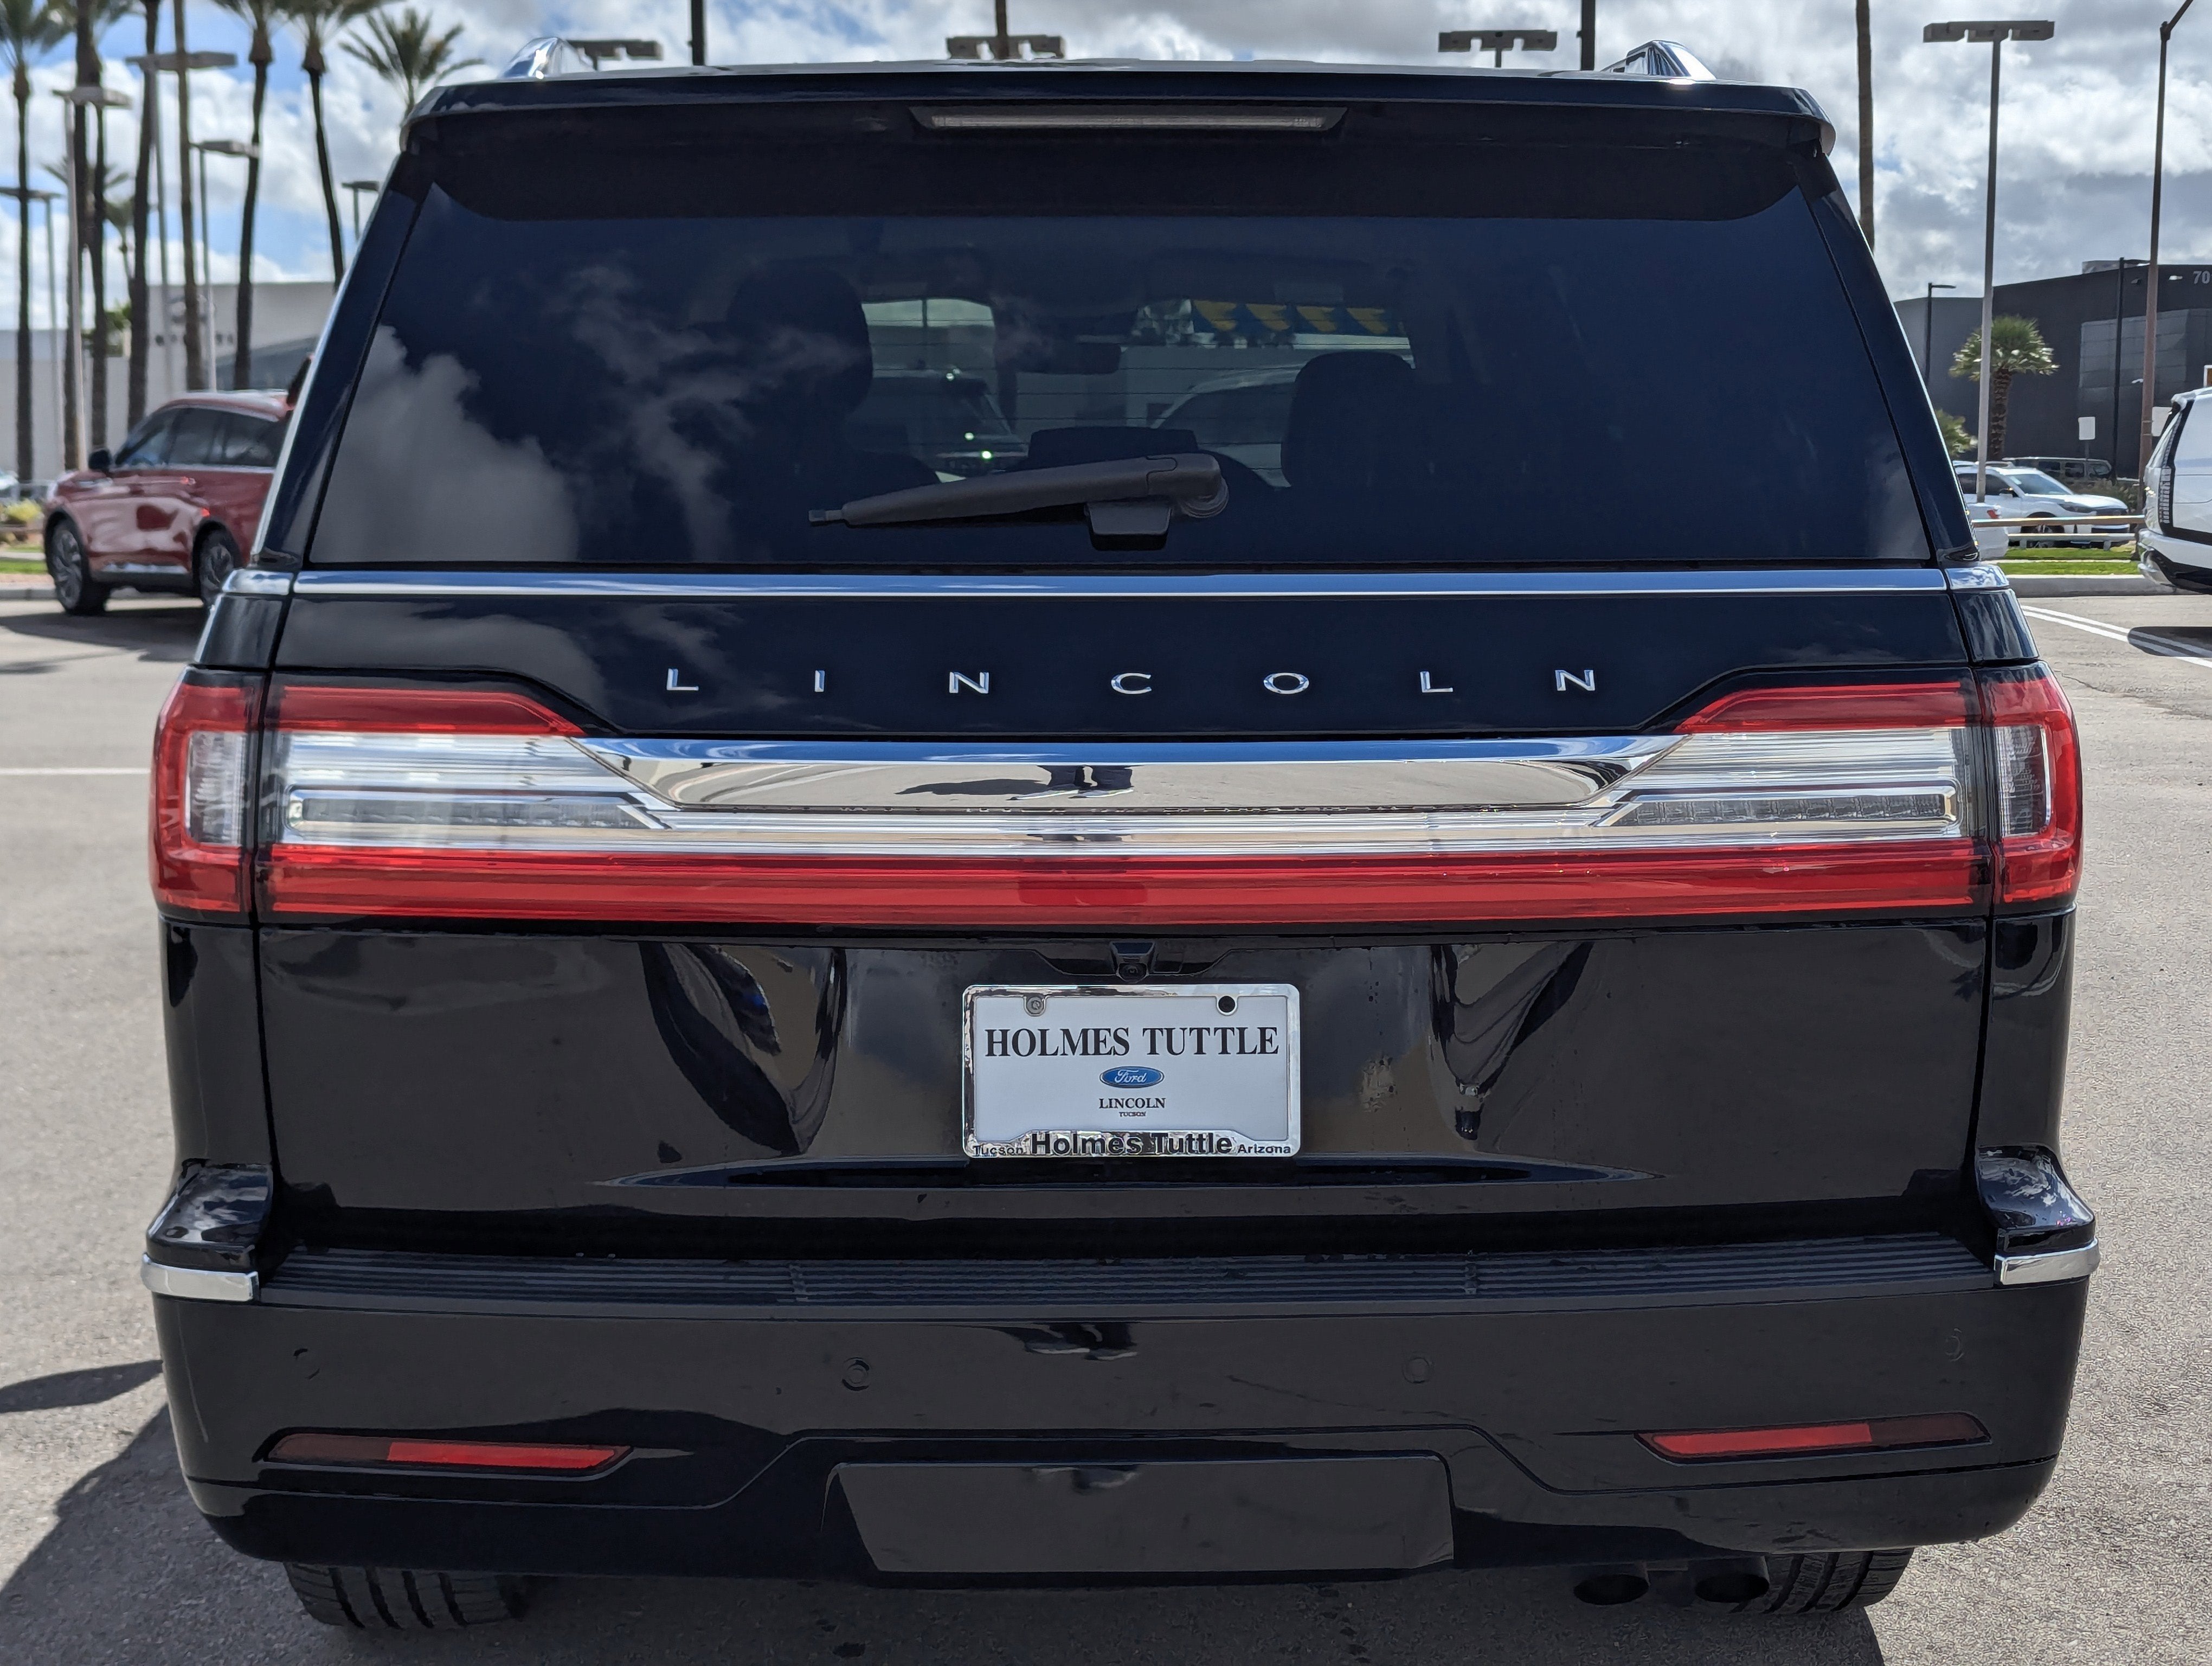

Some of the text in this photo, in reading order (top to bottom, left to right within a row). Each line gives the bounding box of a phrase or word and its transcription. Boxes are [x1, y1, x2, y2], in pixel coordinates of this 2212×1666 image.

[2193, 271, 2212, 284] 70
[666, 668, 1596, 695] LINCOLN
[985, 1026, 1279, 1057] HOLMES TUTTLE
[1114, 1069, 1147, 1083] Ford
[1098, 1097, 1166, 1109] LINCOLN
[973, 1132, 1291, 1156] Tucson Holmes Tuttle Arizona
